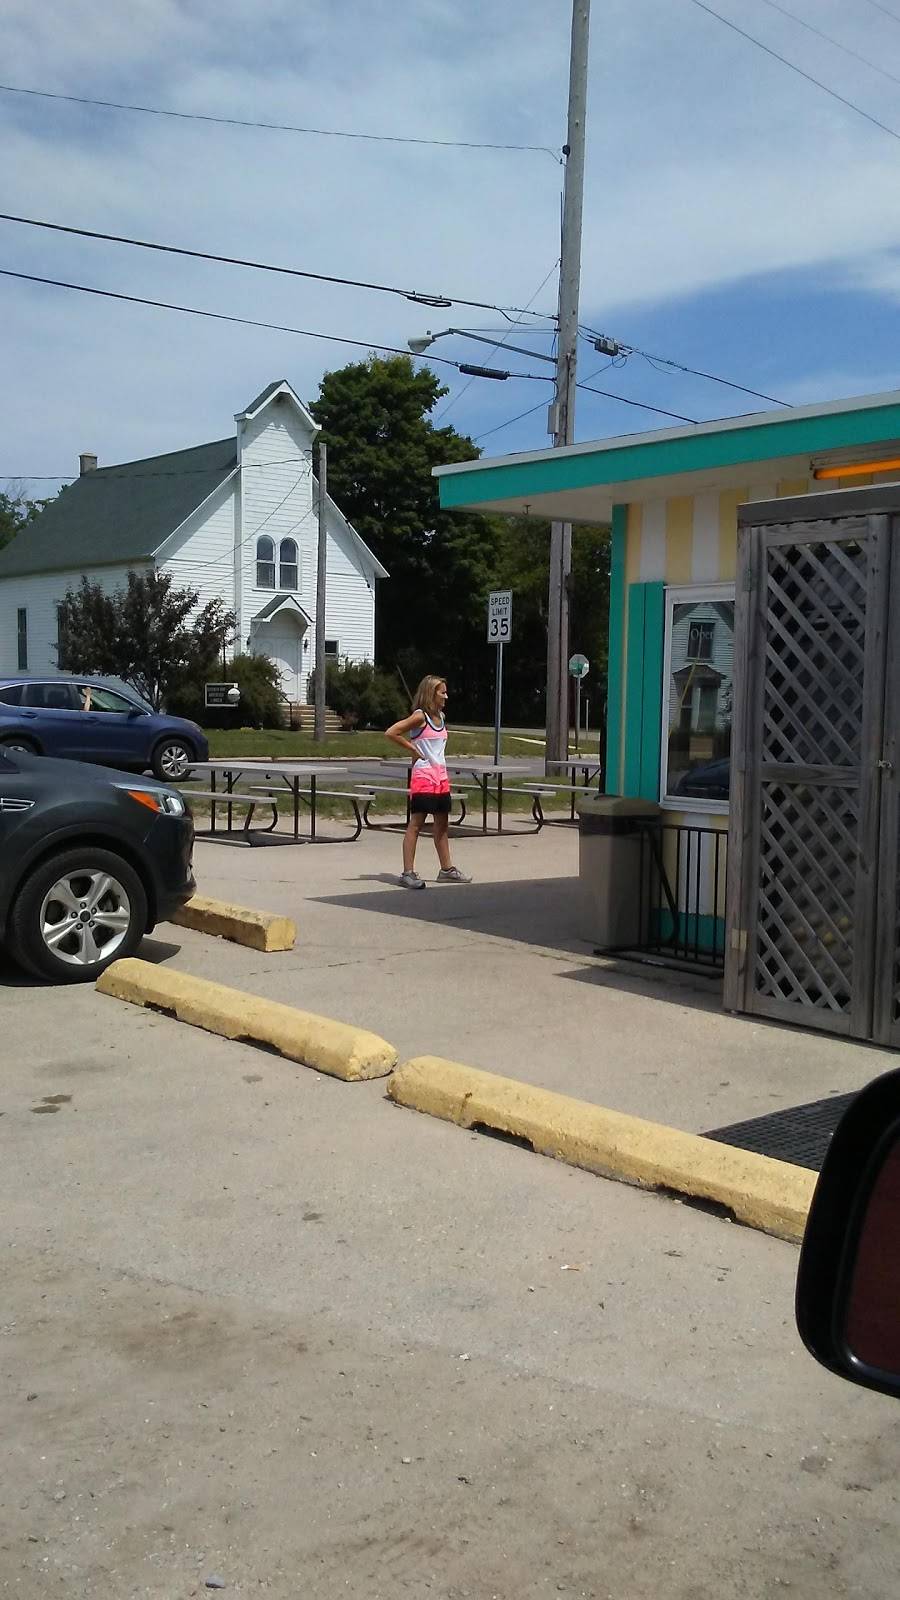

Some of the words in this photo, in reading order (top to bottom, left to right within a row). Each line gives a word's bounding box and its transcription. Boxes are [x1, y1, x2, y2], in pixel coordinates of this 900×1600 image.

[490, 596, 509, 606] SPEED
[492, 608, 507, 616] LIMIT
[490, 618, 508, 636] 35
